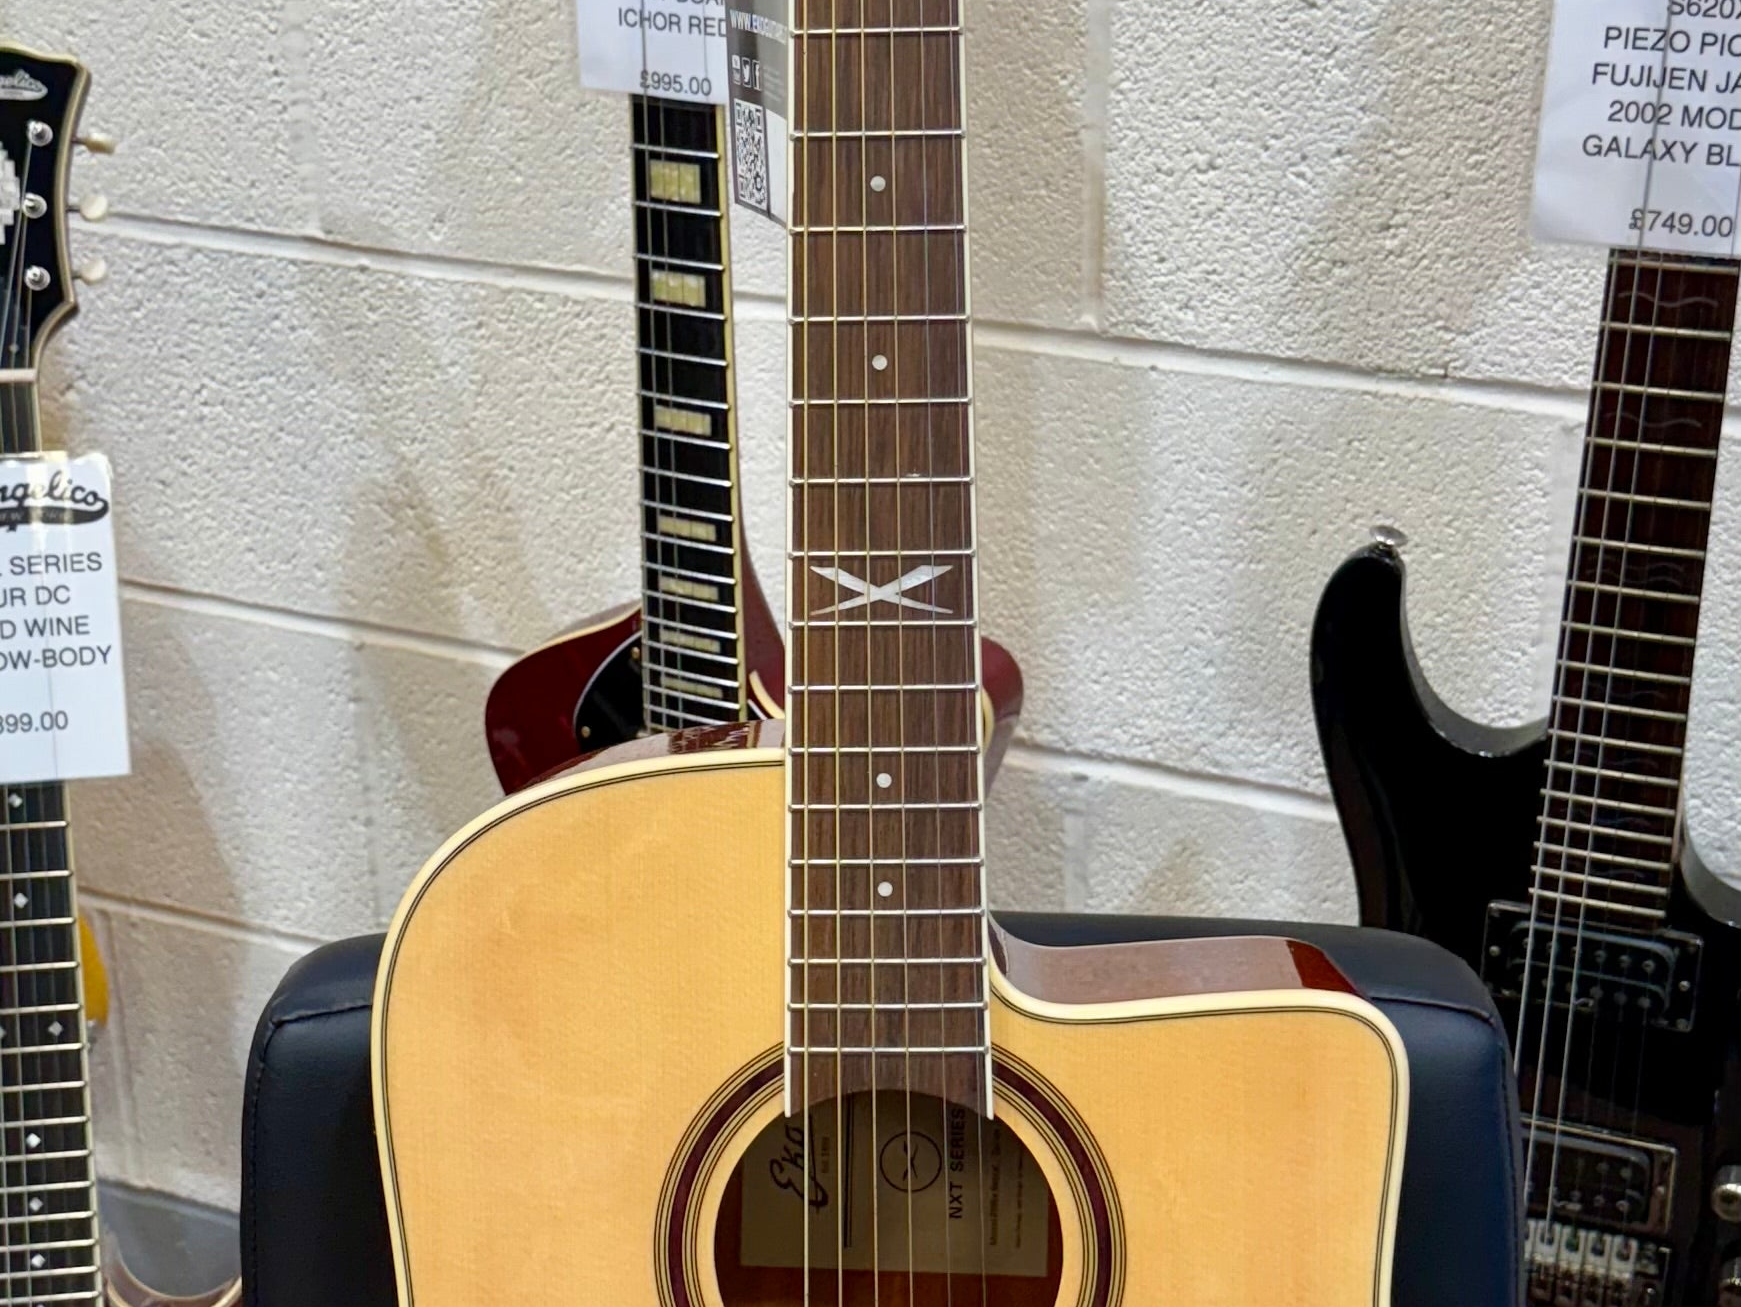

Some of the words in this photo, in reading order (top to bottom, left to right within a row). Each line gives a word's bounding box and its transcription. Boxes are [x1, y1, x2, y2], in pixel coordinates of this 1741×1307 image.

[618, 7, 682, 34] ICHOR
[1603, 26, 1691, 54] PIEZO
[639, 70, 712, 96] £995.00
[1591, 63, 1708, 92] FUJIJEN
[1607, 100, 1672, 125] 2002
[1582, 134, 1698, 164] GALAXY
[1629, 208, 1734, 238] £749.00
[10, 552, 102, 576] SERIES
[35, 584, 71, 606] DC
[24, 615, 90, 637] WINE
[949, 1108, 965, 1172] SERIES
[770, 1112, 828, 1212] Eko
[949, 1182, 963, 1219] NXT
